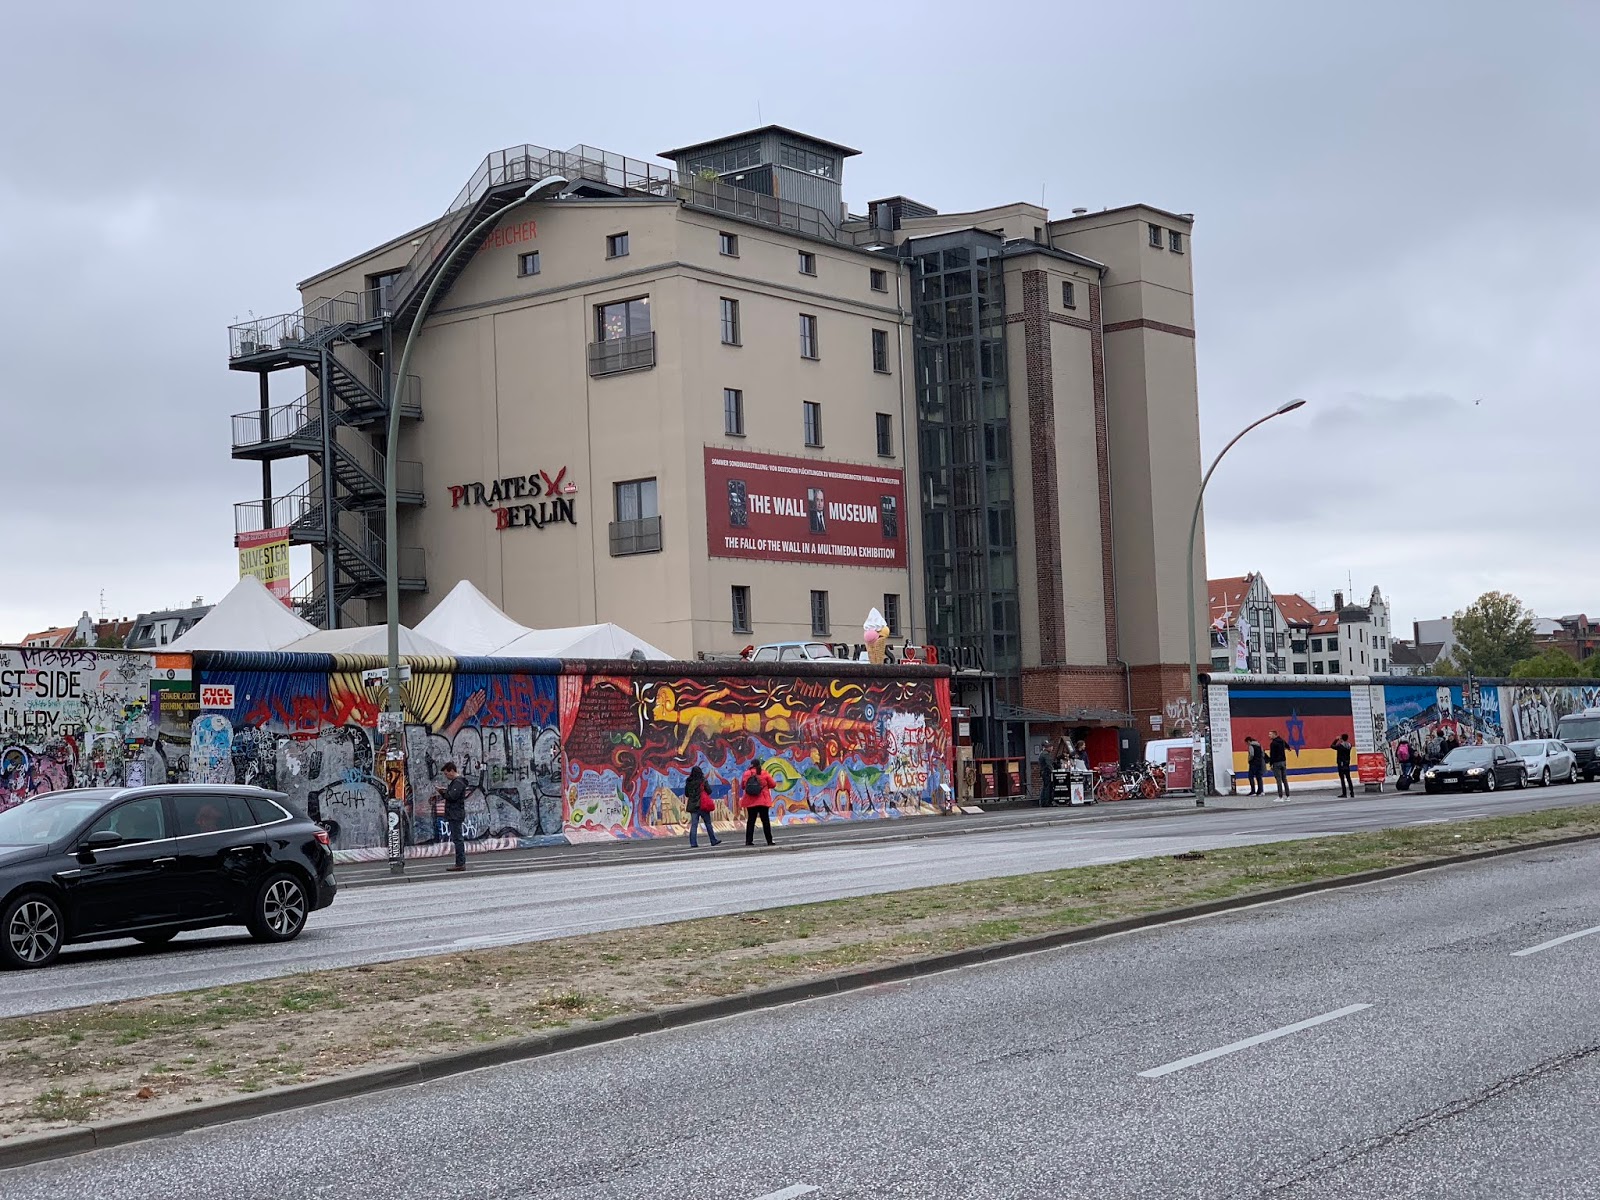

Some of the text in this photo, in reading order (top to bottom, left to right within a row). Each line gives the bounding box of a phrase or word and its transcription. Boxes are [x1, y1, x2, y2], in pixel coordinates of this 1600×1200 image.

[447, 474, 542, 508] PIRATES
[491, 497, 577, 531] BERLIN
[749, 494, 878, 523] THE WALL MUSEUM
[240, 543, 287, 570] SILVESTER
[725, 536, 895, 559] THE FALL OF THE WALL IN A MULTIMEDIA EXHIBITION
[0, 670, 81, 698] ST SIDE
[202, 688, 233, 697] FUCK
[202, 697, 233, 706] WARS
